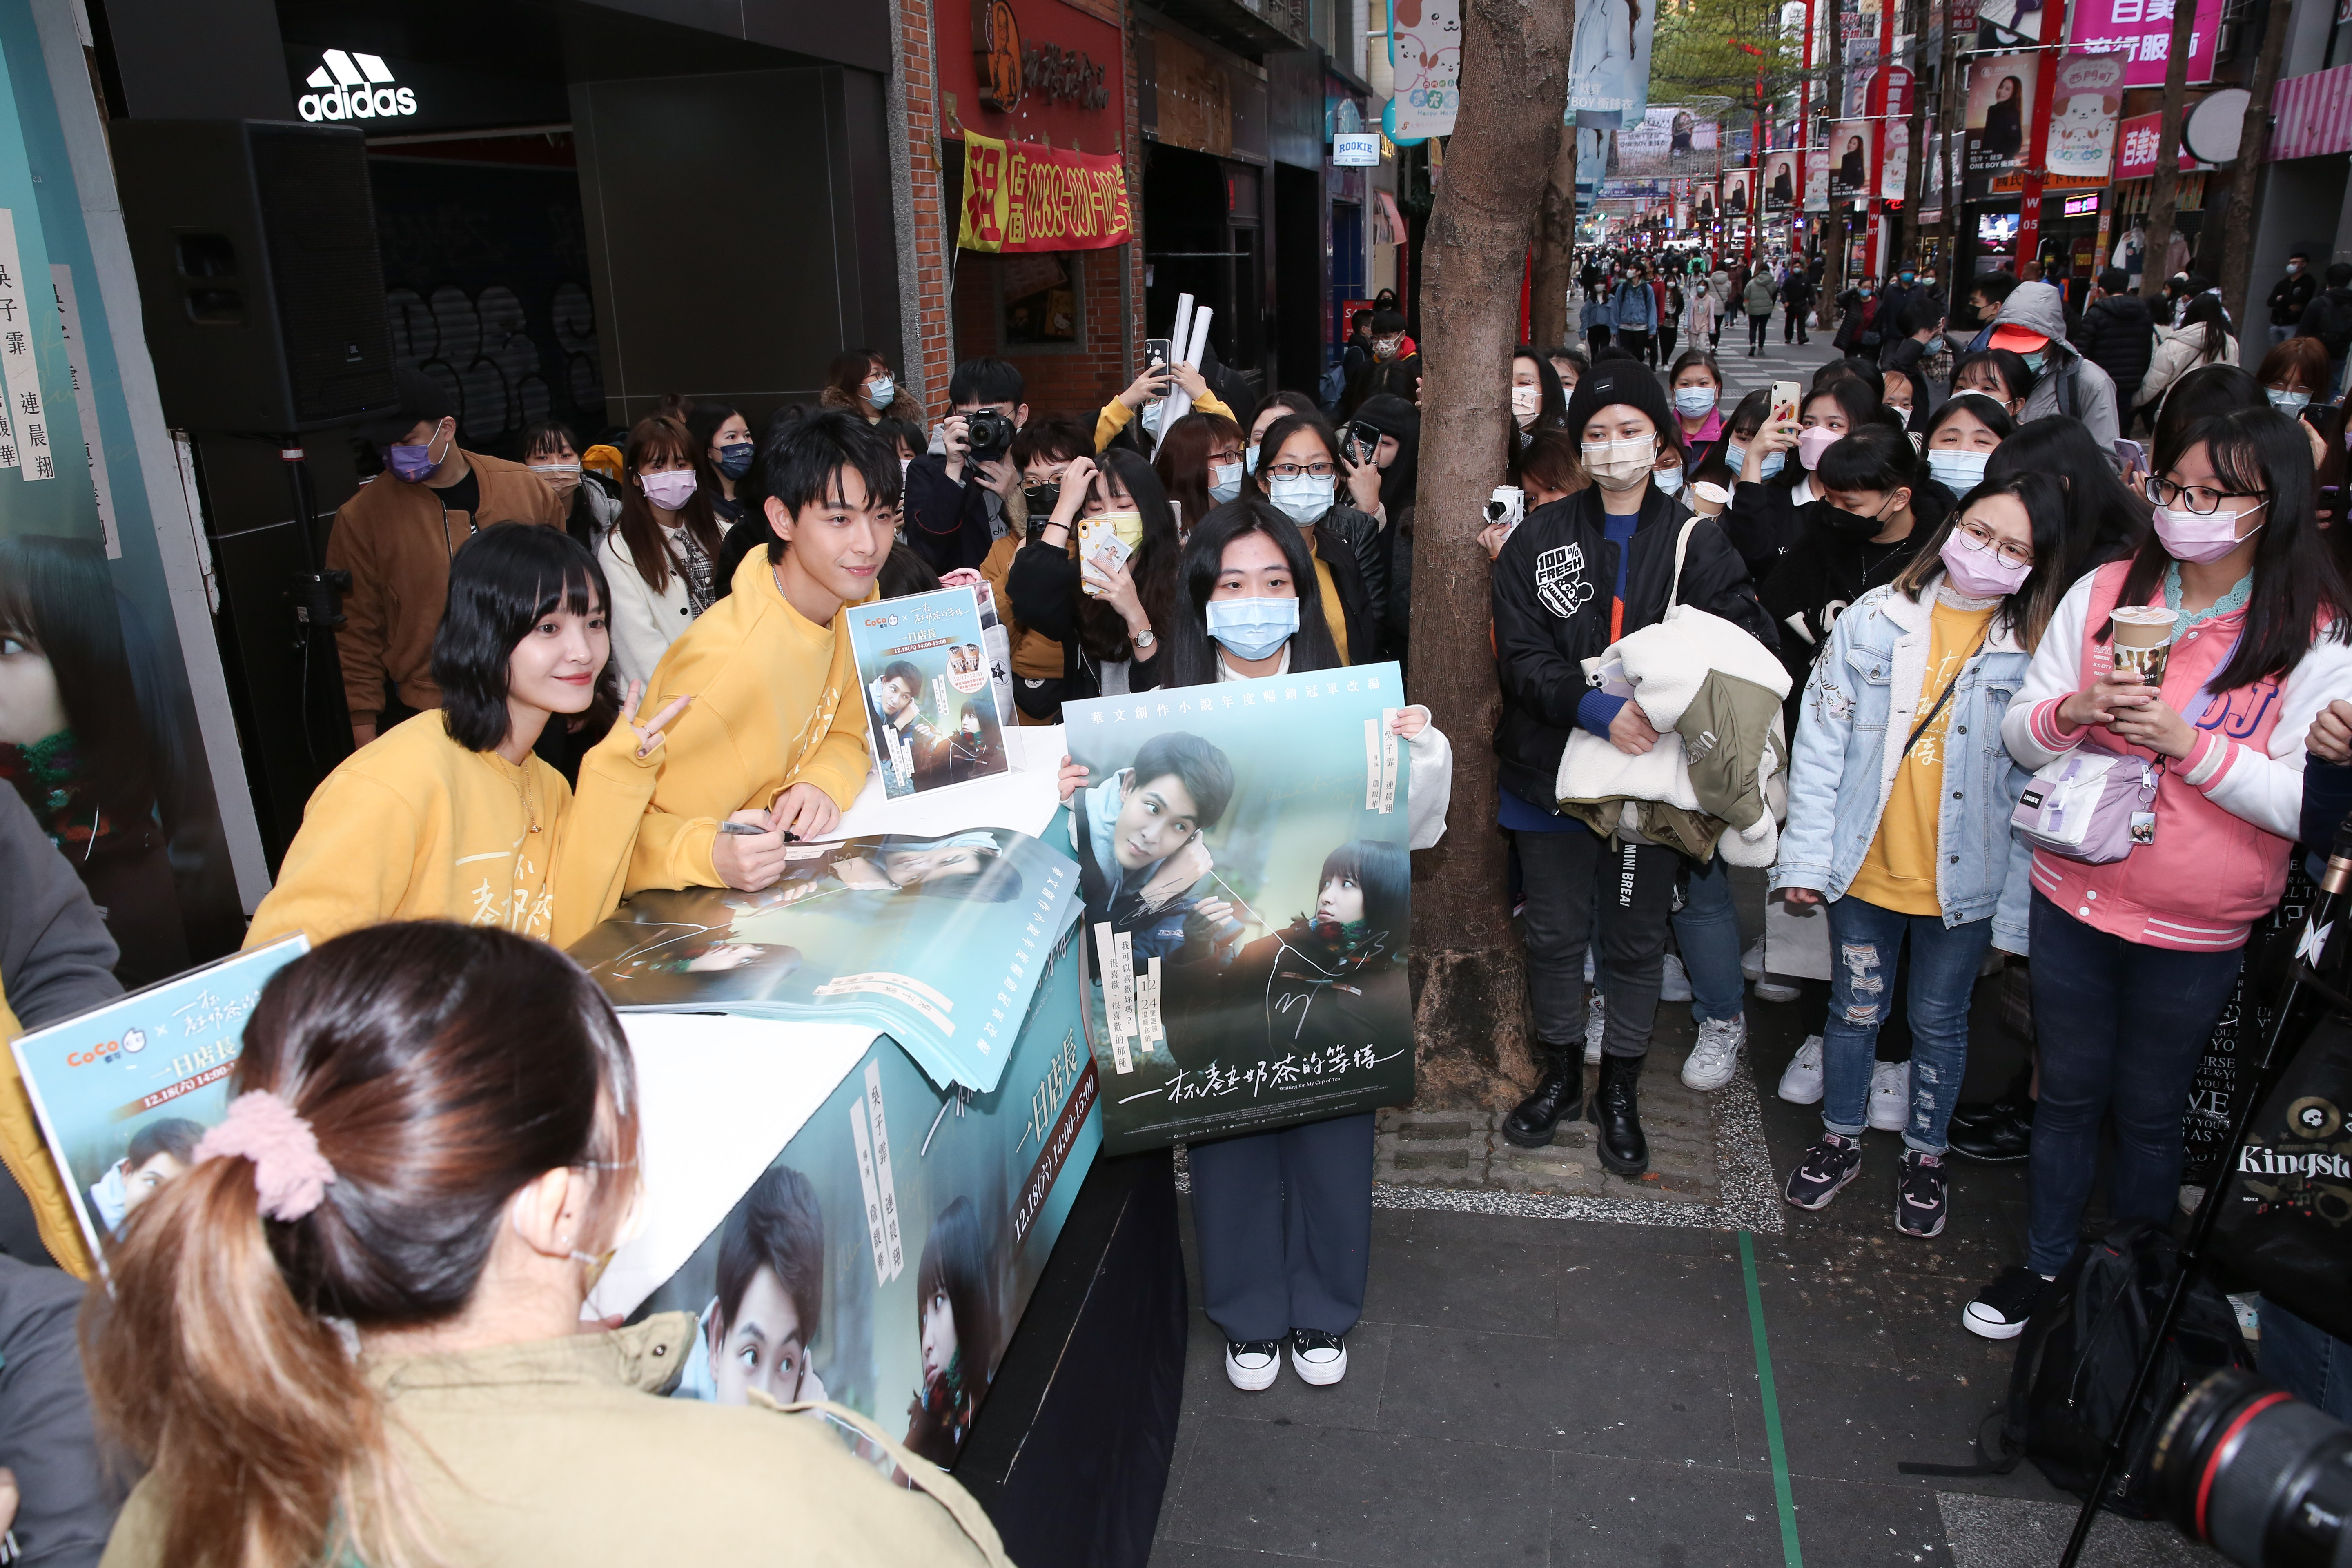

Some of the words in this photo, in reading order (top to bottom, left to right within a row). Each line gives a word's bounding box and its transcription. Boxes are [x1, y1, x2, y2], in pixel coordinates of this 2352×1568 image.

[298, 84, 417, 122] adidas
[1571, 97, 1595, 107] BOY
[1339, 141, 1372, 154] ROOKIE
[969, 145, 1001, 242] 租
[1008, 151, 1026, 243] 店面
[2027, 198, 2040, 208] W
[2023, 220, 2038, 230] 05
[20, 391, 54, 479] 連晨翔
[1537, 558, 1582, 584] FRESH
[1538, 542, 1580, 571] 100%
[898, 628, 937, 643] 一日店長
[918, 639, 947, 649] 14:00-15:00
[1090, 676, 1380, 725] 華文創作小說年度暢銷冠軍改編
[1384, 731, 1394, 767] 吳子霏
[1372, 779, 1380, 808] 詹馥華
[1385, 780, 1394, 813] 連晨翔
[2023, 794, 2039, 805] FASHION
[1624, 844, 1637, 871] MINI
[1141, 979, 1156, 991] 12
[1141, 998, 1157, 1010] 24
[1149, 1010, 1158, 1033] 聖誕節
[149, 1036, 237, 1078] 一日店長
[1118, 1042, 1405, 1105] 一杯熱奶茶的等待
[2196, 1078, 2220, 1089] YOU
[144, 1078, 196, 1108] 12.18(六)
[1016, 1027, 1078, 1154] 一日店長
[1052, 1074, 1094, 1167] 14:00-15:00
[872, 1085, 888, 1165] 吳子霏
[884, 1192, 902, 1271] 連晨翔
[869, 1203, 885, 1272] 詹馥華
